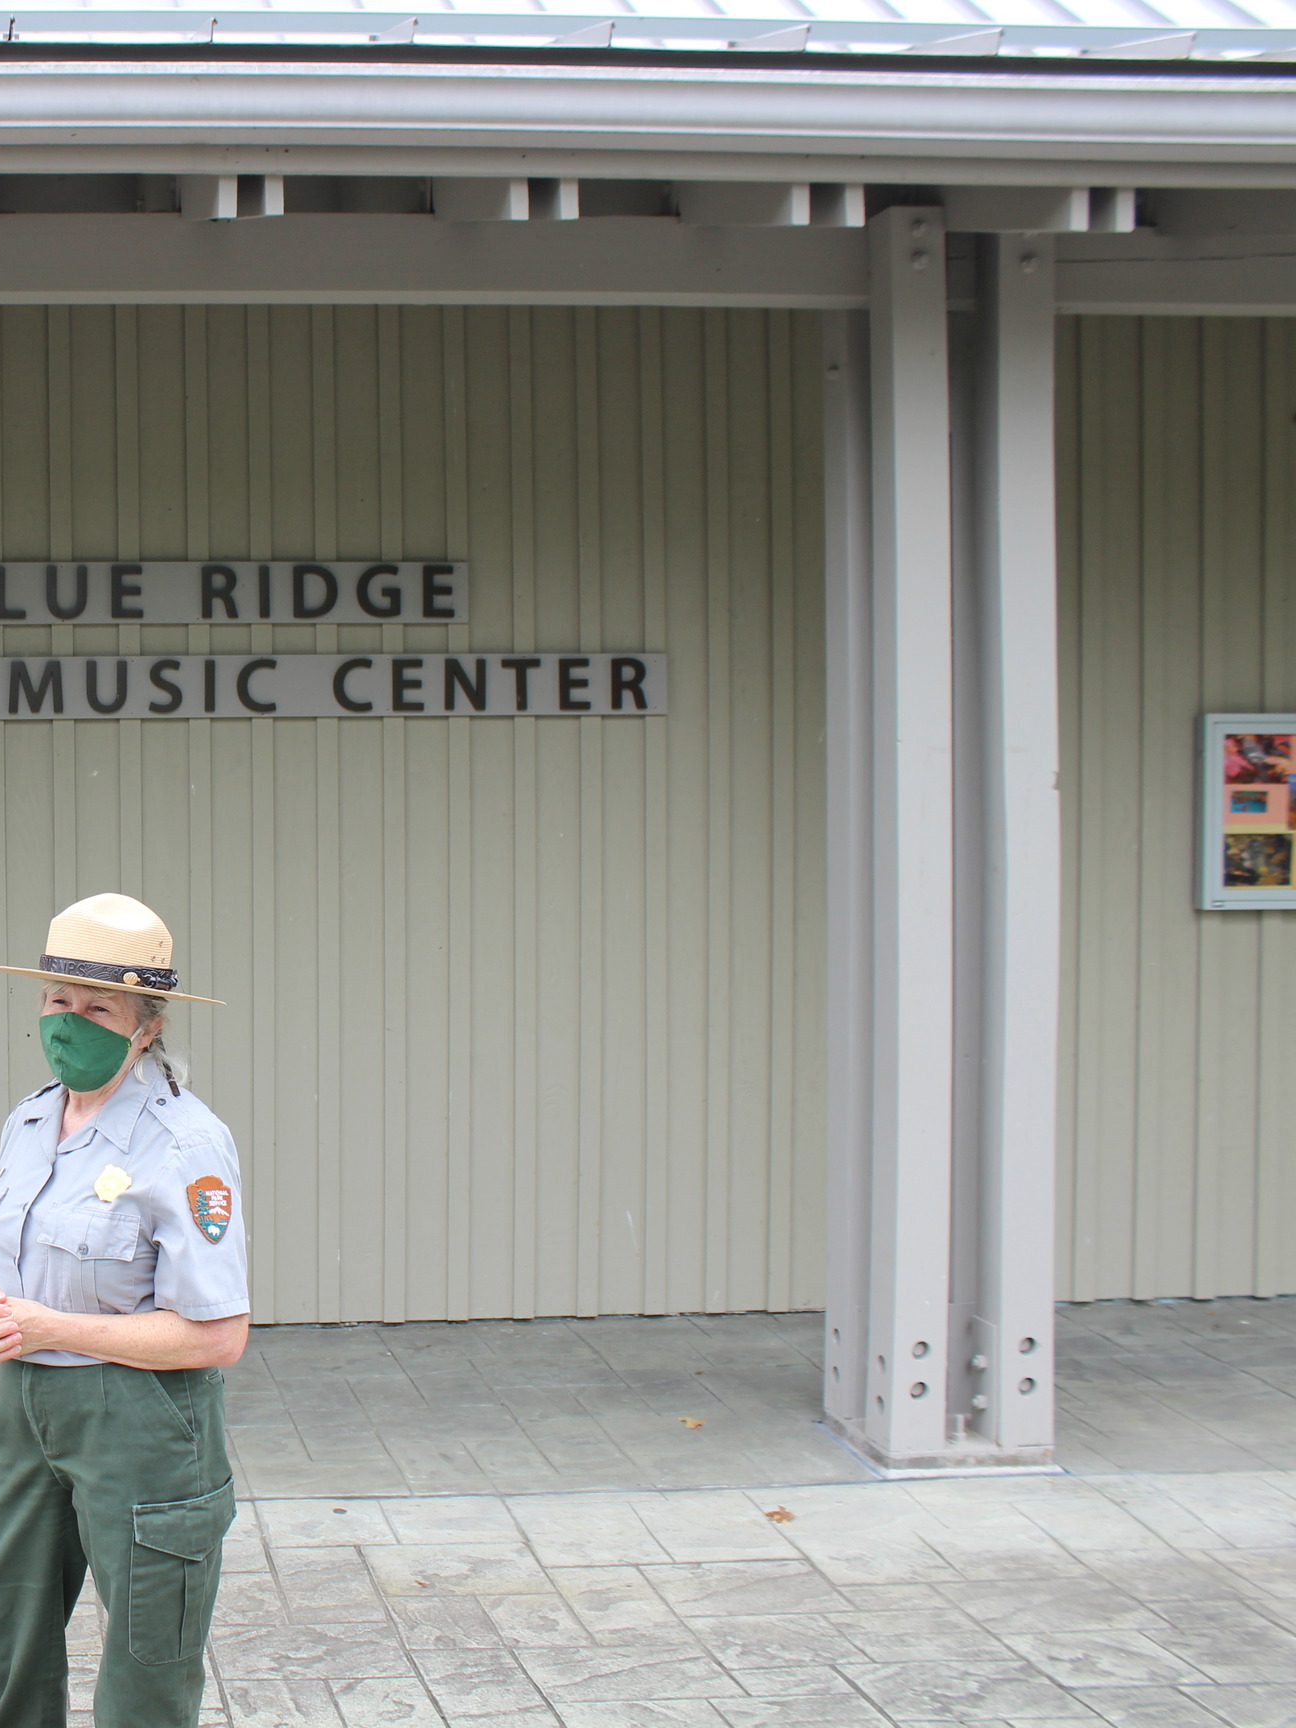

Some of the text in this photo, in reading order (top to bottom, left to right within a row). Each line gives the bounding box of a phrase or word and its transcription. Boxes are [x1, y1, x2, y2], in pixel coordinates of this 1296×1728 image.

[201, 563, 456, 620] RIDGE
[7, 657, 649, 715] MUSIC CENTER
